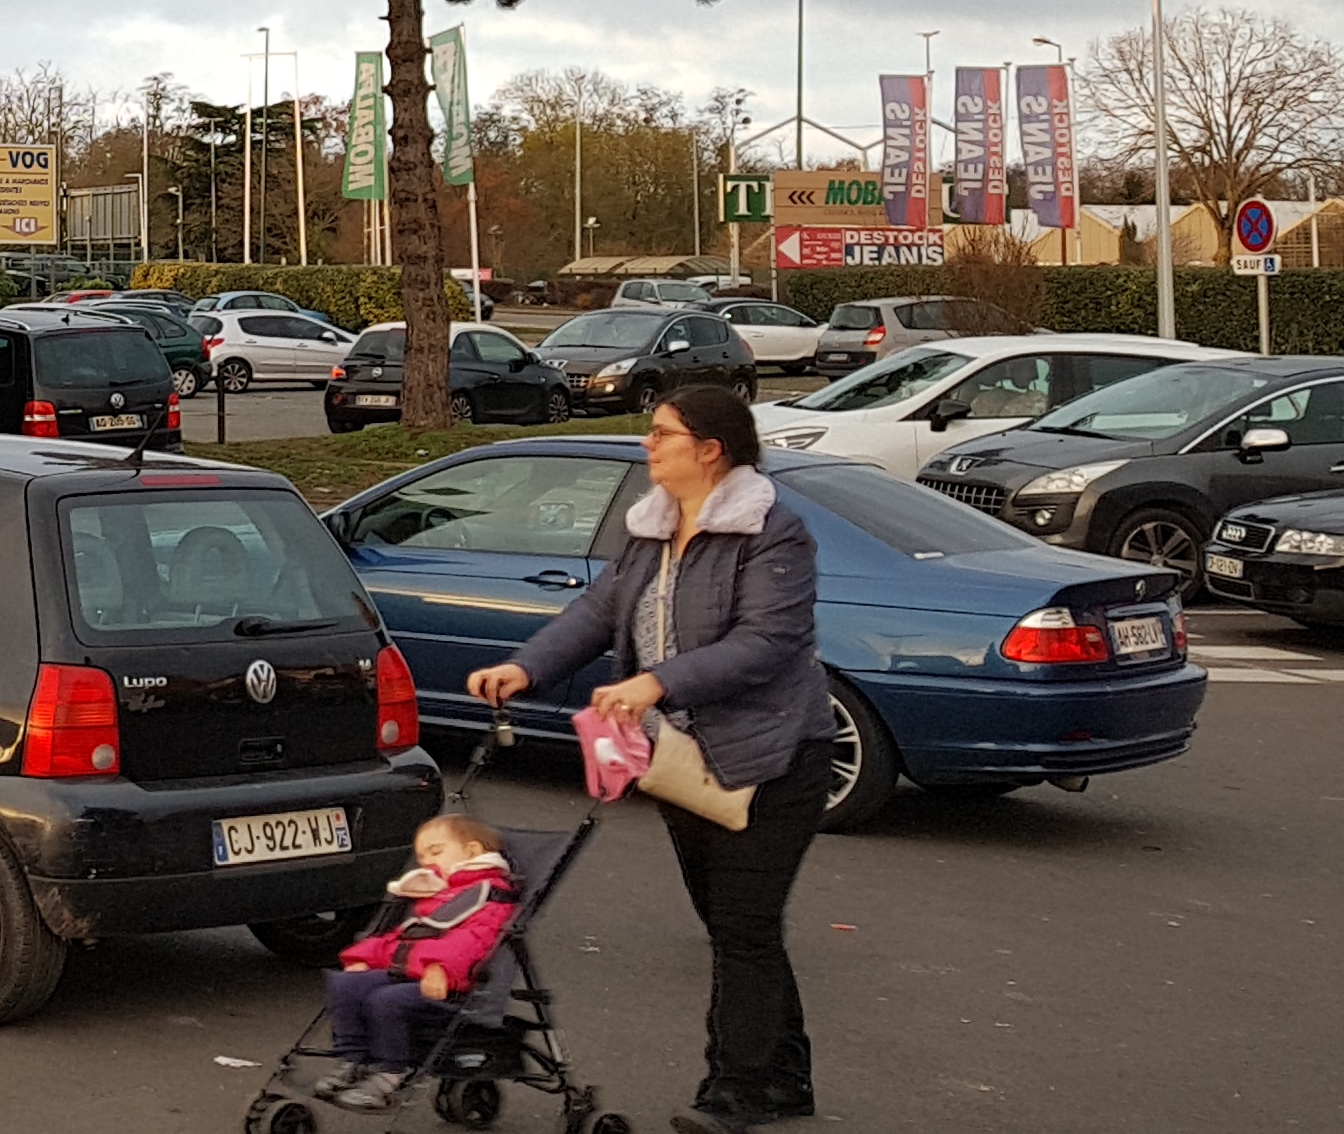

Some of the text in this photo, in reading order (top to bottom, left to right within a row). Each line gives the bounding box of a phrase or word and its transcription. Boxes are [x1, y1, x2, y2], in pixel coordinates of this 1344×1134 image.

[8, 151, 49, 169] VOG
[15, 218, 36, 233] ICI
[845, 231, 942, 245] DESTOCK
[1236, 259, 1261, 271] SAUF
[228, 815, 335, 856] CJ-922-WJ
